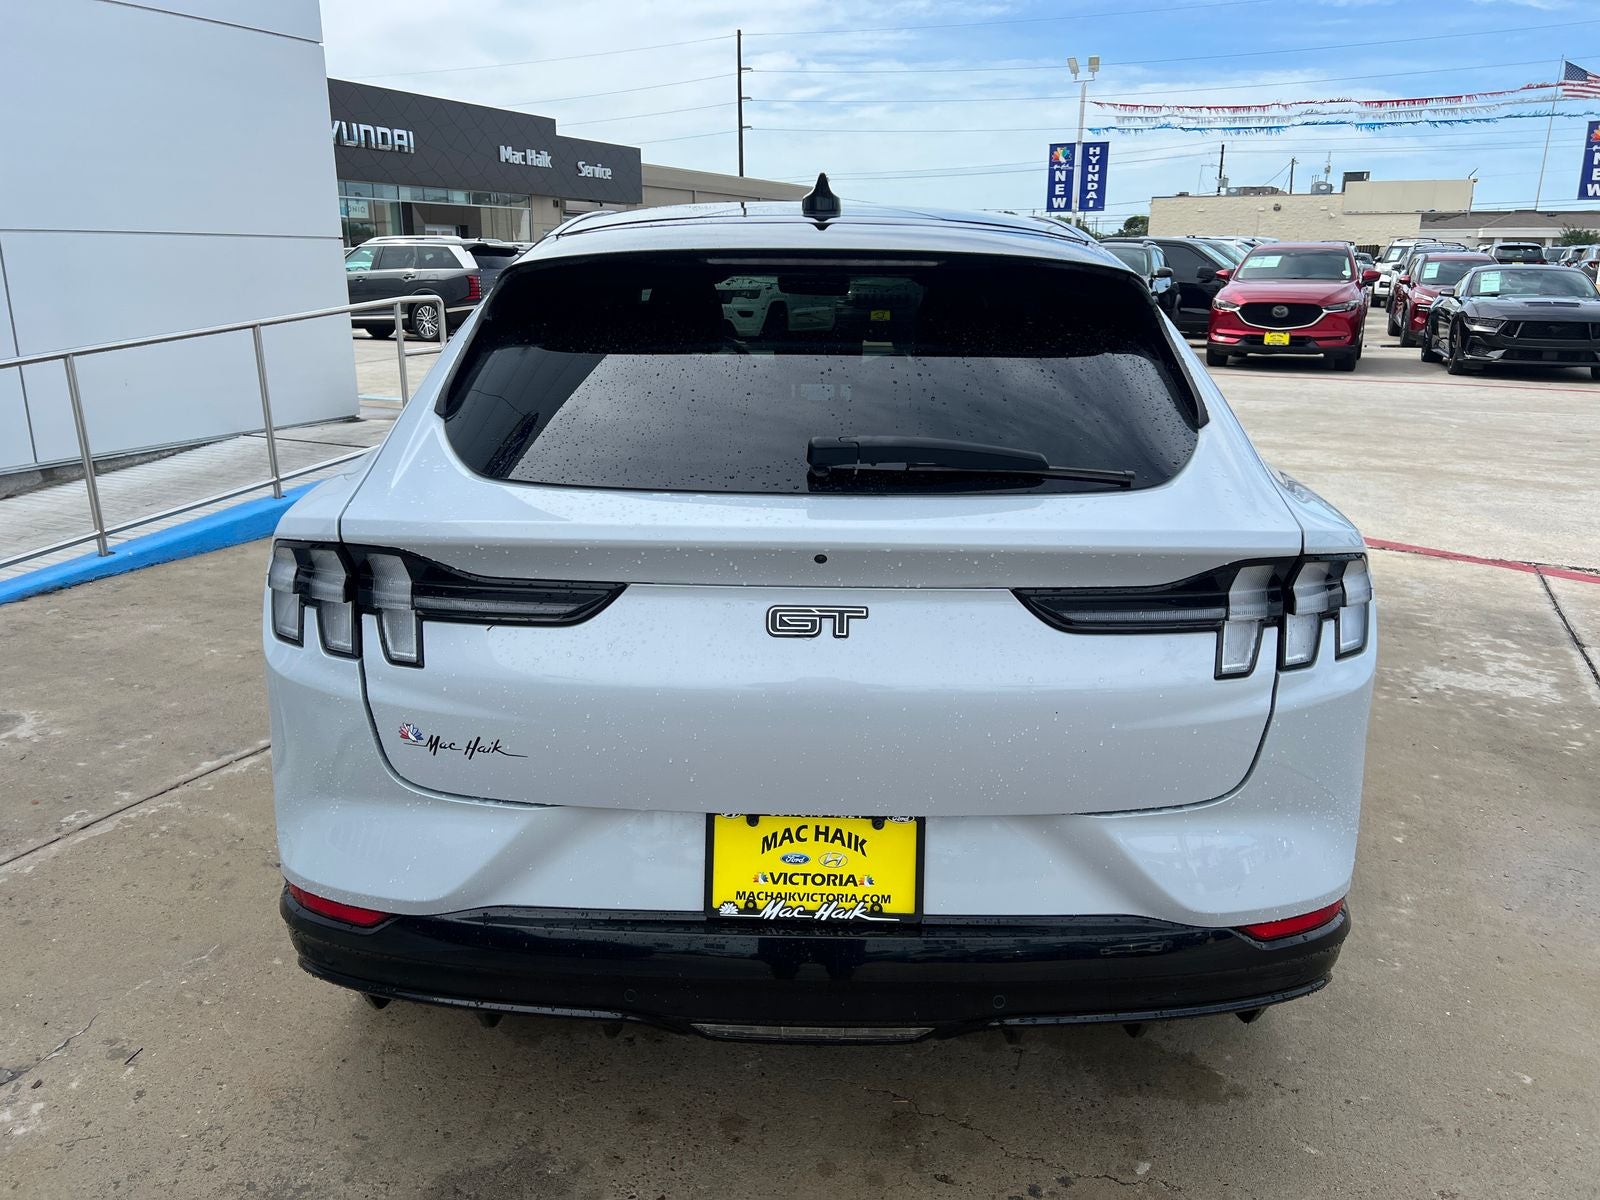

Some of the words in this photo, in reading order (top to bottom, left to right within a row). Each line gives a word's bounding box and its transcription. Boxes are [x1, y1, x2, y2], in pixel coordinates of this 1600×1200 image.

[499, 145, 526, 165] Mac
[526, 148, 553, 168] Haik
[577, 161, 612, 180] Service
[1086, 147, 1101, 208] HYUNDAI
[1052, 170, 1067, 209] NEW
[766, 604, 869, 638] GT
[420, 734, 462, 756] Mac
[464, 736, 515, 760] Haik
[760, 824, 809, 855] MAC
[814, 824, 868, 857] HAIK
[784, 854, 806, 864] Ford
[768, 872, 859, 887] VICTORIA
[735, 890, 892, 904] MACHAIKVICTORIA.COM
[750, 899, 812, 920] Mac
[814, 901, 880, 921] Haik
